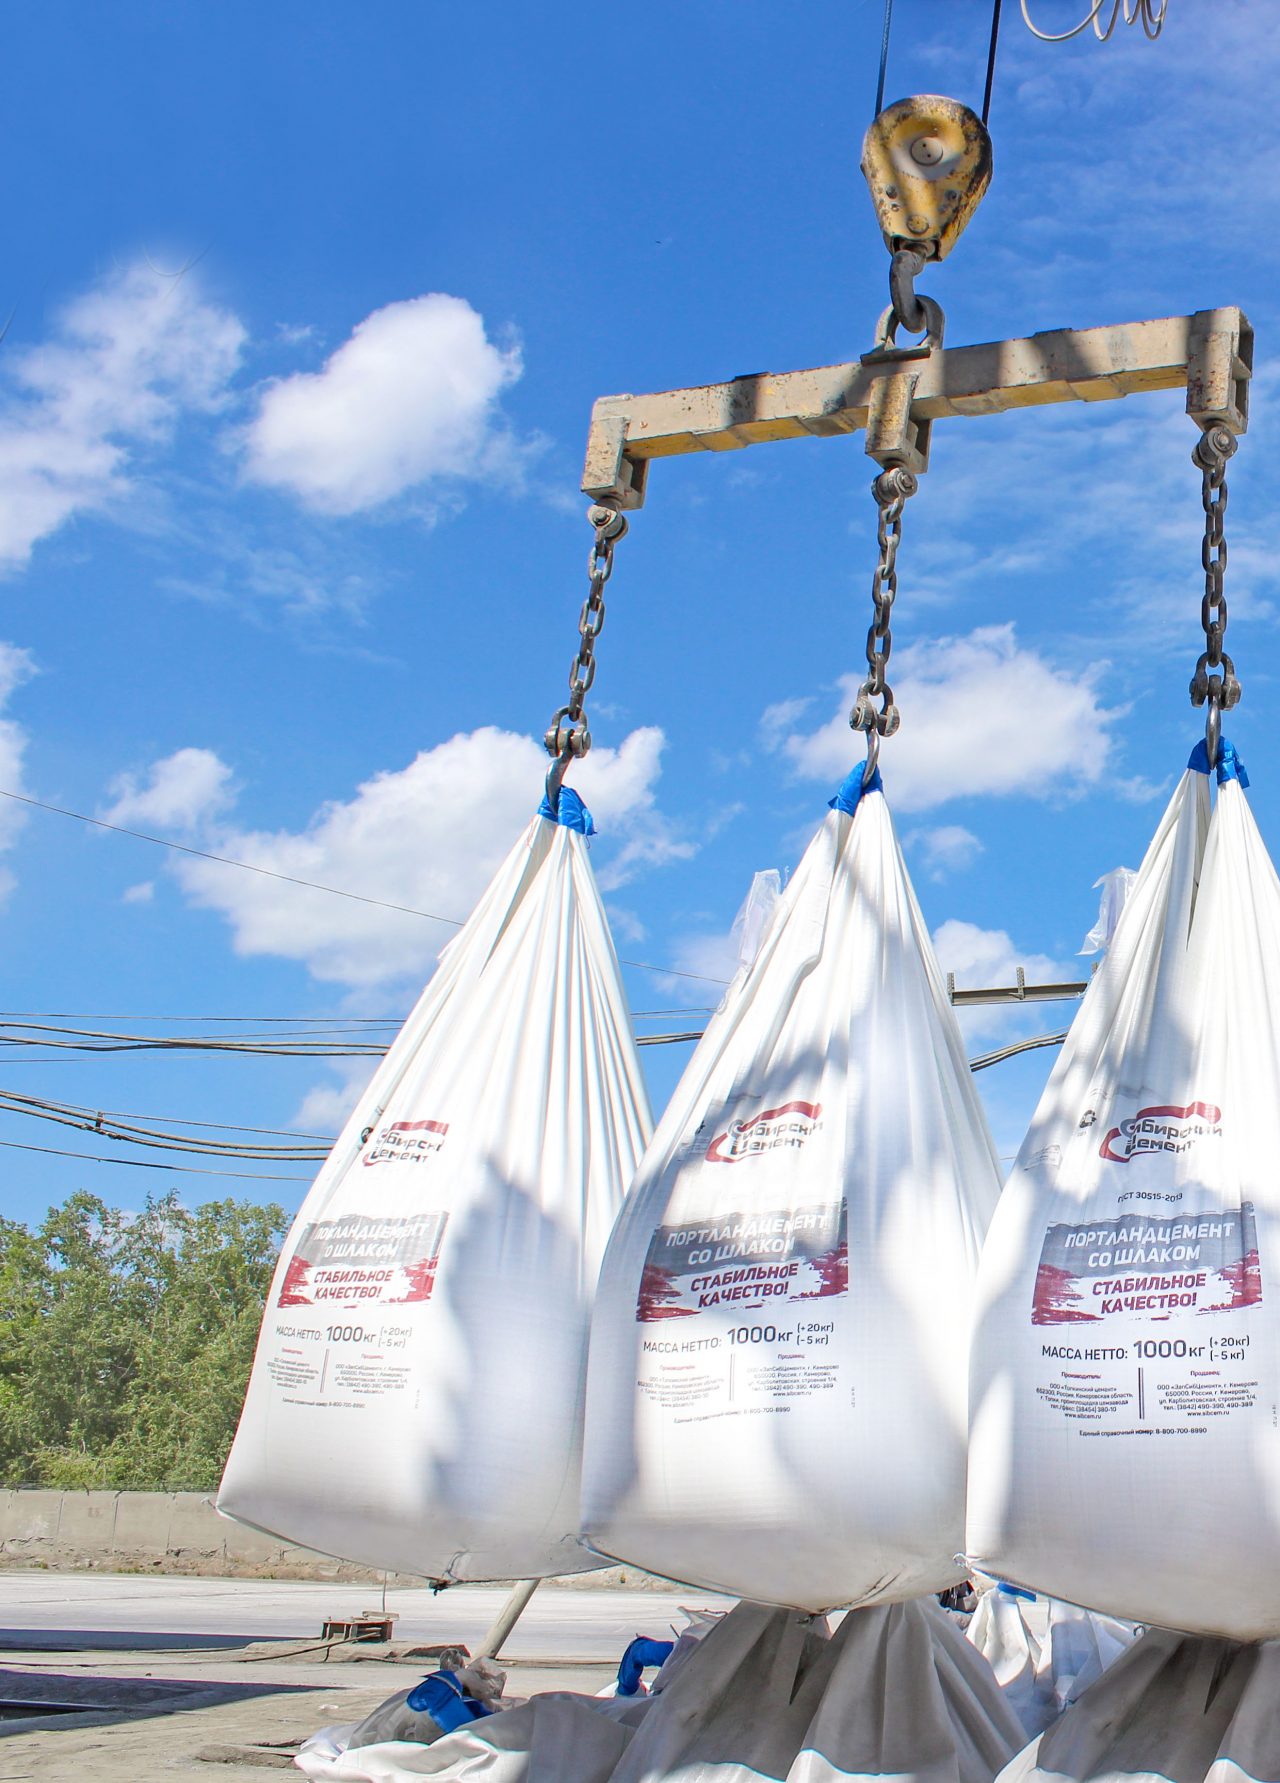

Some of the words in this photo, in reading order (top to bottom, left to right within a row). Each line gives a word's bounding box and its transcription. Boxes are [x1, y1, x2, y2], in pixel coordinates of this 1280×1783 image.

[1065, 1223, 1235, 1248] ПОРТЛАНДЦЕМЕНТ
[333, 1244, 399, 1258] ШЛАКОМ
[688, 1249, 711, 1265] СО
[1088, 1252, 1112, 1268] СО
[1113, 1245, 1201, 1266] ШЛАКОМ
[314, 1270, 394, 1284] СТАБИЛЬНОЕ
[691, 1263, 799, 1292] СТАБИЛЬНОЕ
[1092, 1273, 1207, 1296] СТАБИЛЬНОЕ
[314, 1286, 382, 1300] КАЧЕСТВО!
[698, 1281, 789, 1308] КАЧЕСТВО!
[1101, 1292, 1197, 1314] КАЧЕСТВО!
[275, 1325, 296, 1337] МАССА
[297, 1328, 322, 1341] НЕТТО:
[326, 1326, 364, 1342] 1000
[364, 1333, 376, 1343] кг
[643, 1341, 679, 1353] МАССА
[681, 1337, 722, 1353] НЕТТО:
[727, 1326, 777, 1345] 1000
[778, 1332, 793, 1342] кг
[1041, 1345, 1082, 1359] МАССА
[1085, 1347, 1128, 1360] НЕТТО:
[1133, 1340, 1187, 1358] 1000
[1189, 1347, 1205, 1357] кг
